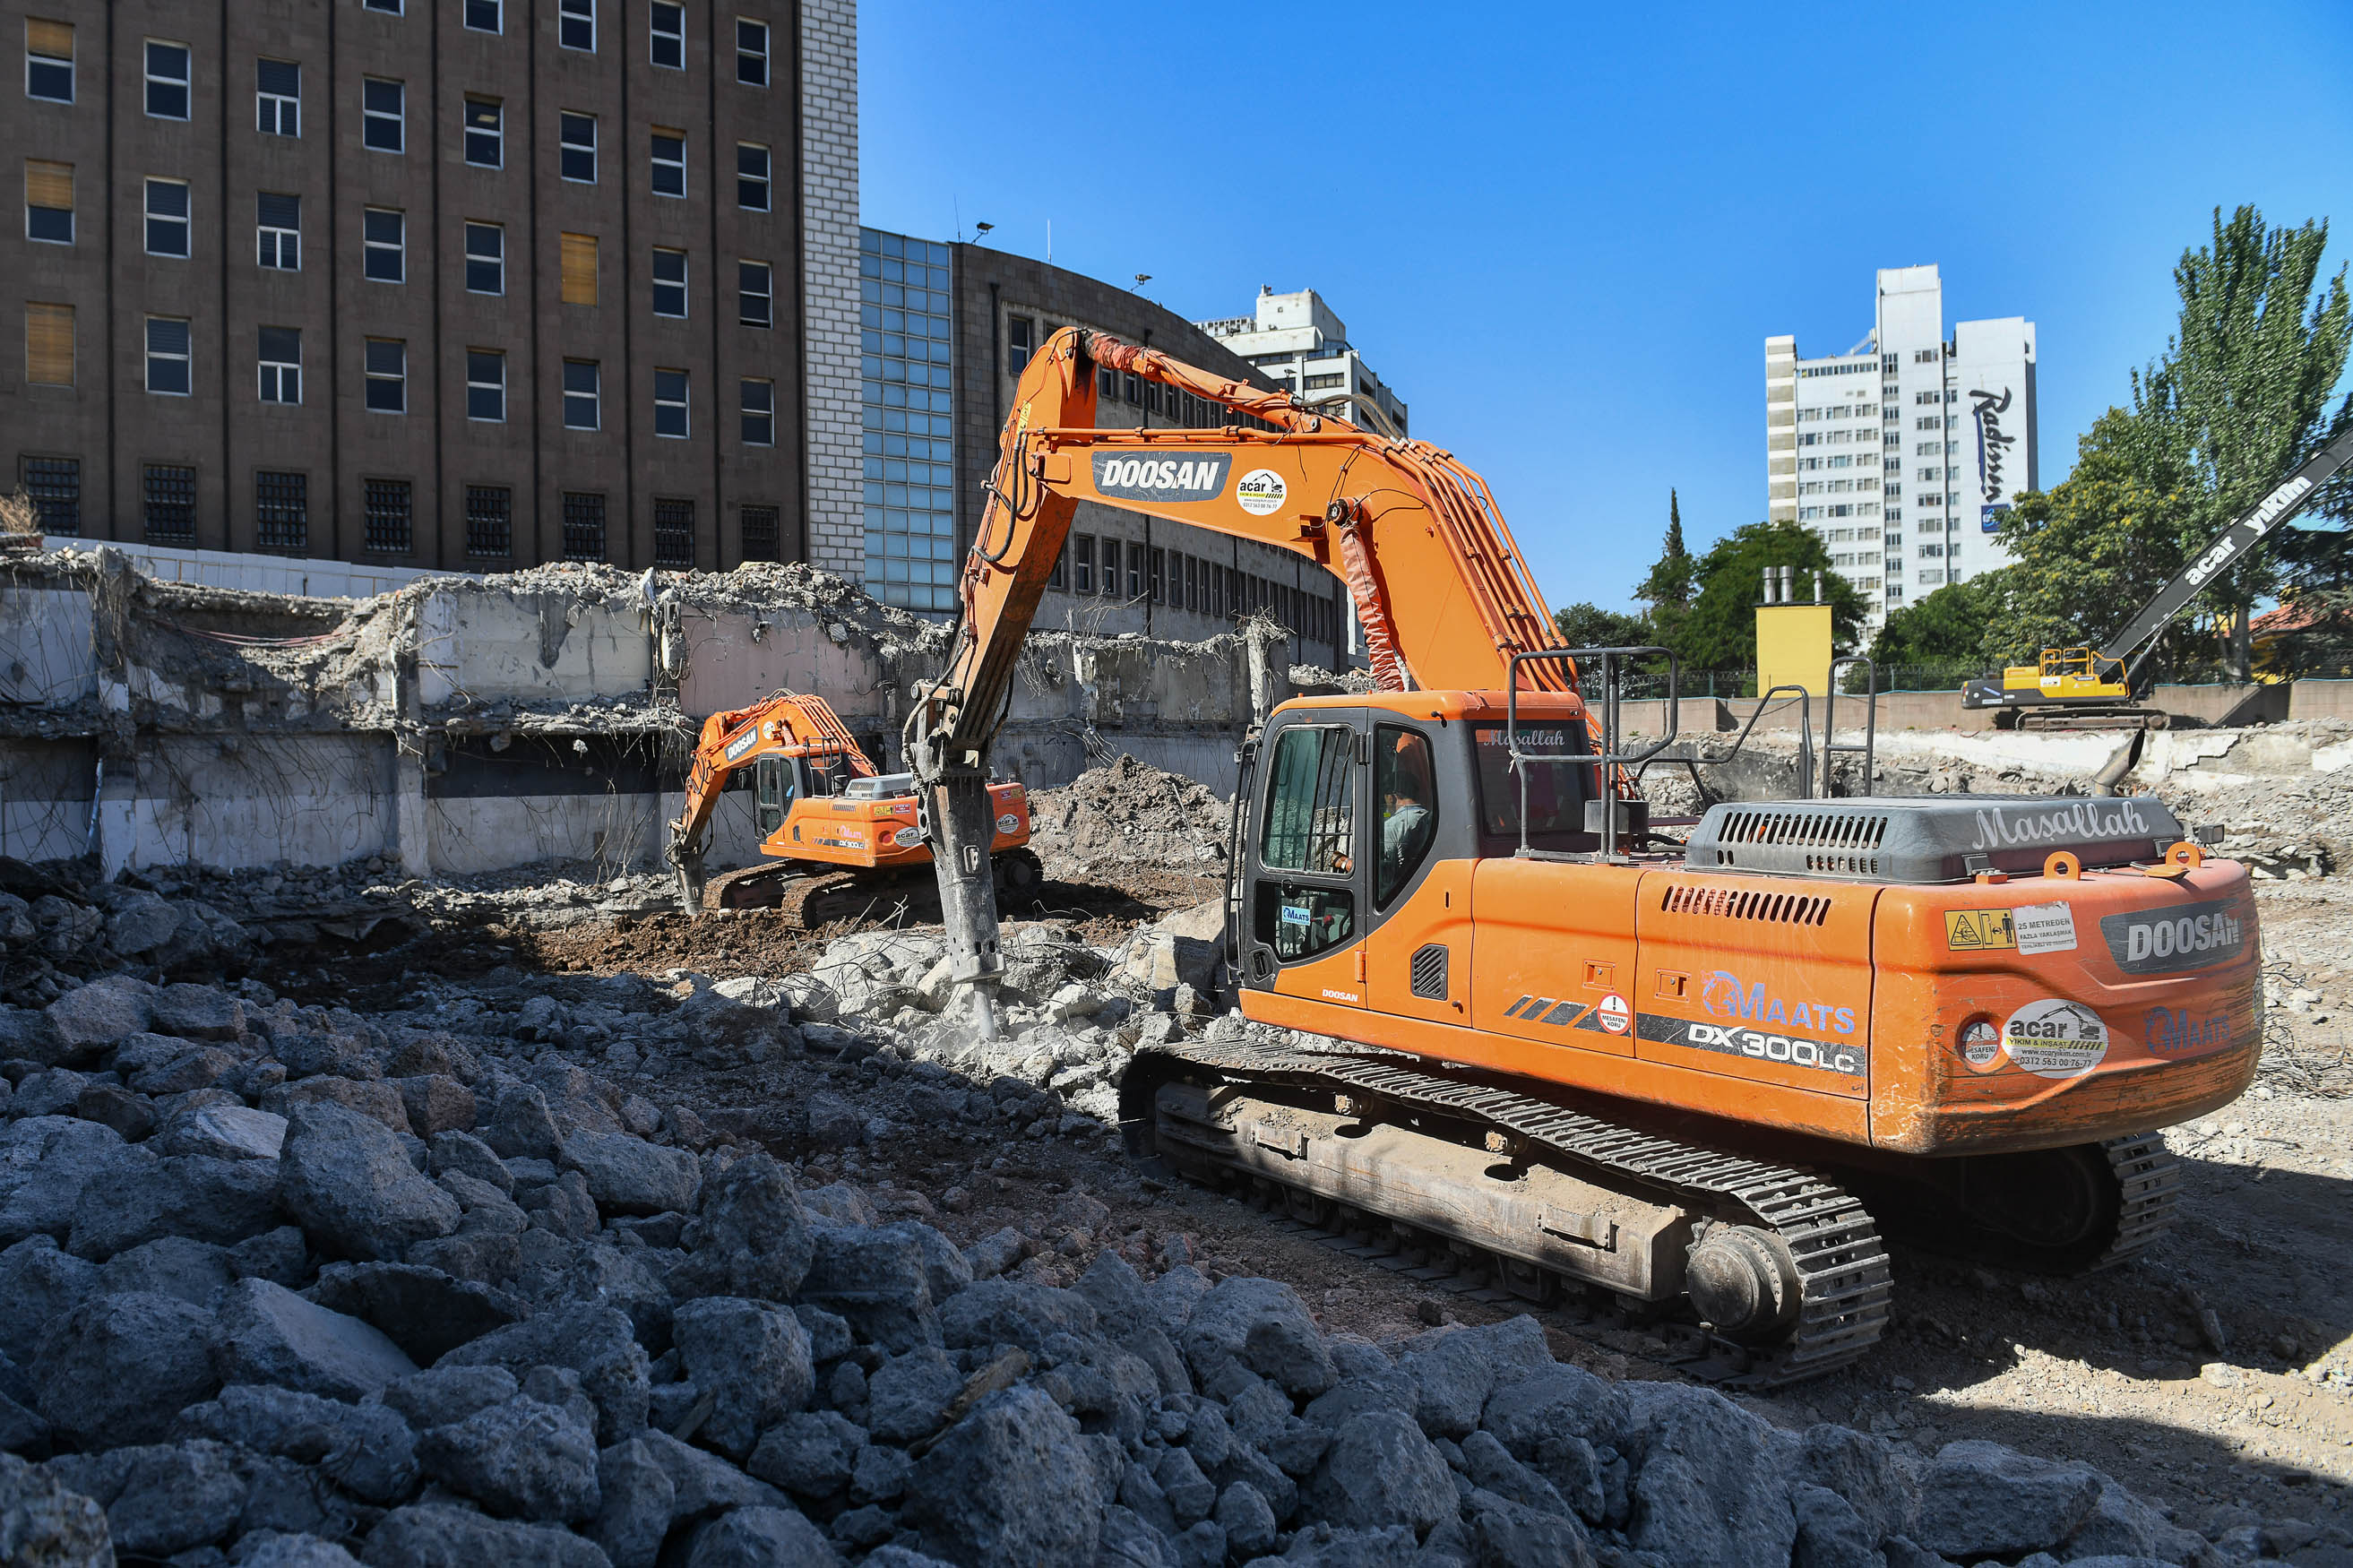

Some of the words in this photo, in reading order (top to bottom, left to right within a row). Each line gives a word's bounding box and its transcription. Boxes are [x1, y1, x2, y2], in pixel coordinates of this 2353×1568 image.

[1969, 386, 2015, 503] Radisson
[1101, 460, 1220, 490] DOOSAN
[1240, 482, 1266, 492] acar
[2185, 536, 2237, 586] acar
[728, 729, 756, 760] DOOSAN
[1284, 907, 1310, 921] MAATS
[2030, 918, 2071, 929] METREDEN
[2127, 913, 2239, 961] DOOSAN
[1322, 989, 1358, 1002] DOOSAN
[1713, 970, 1856, 1034] MAATS
[2009, 1020, 2067, 1038] acar
[2150, 1005, 2230, 1050] MAATS
[2042, 1057, 2056, 1065] 563
